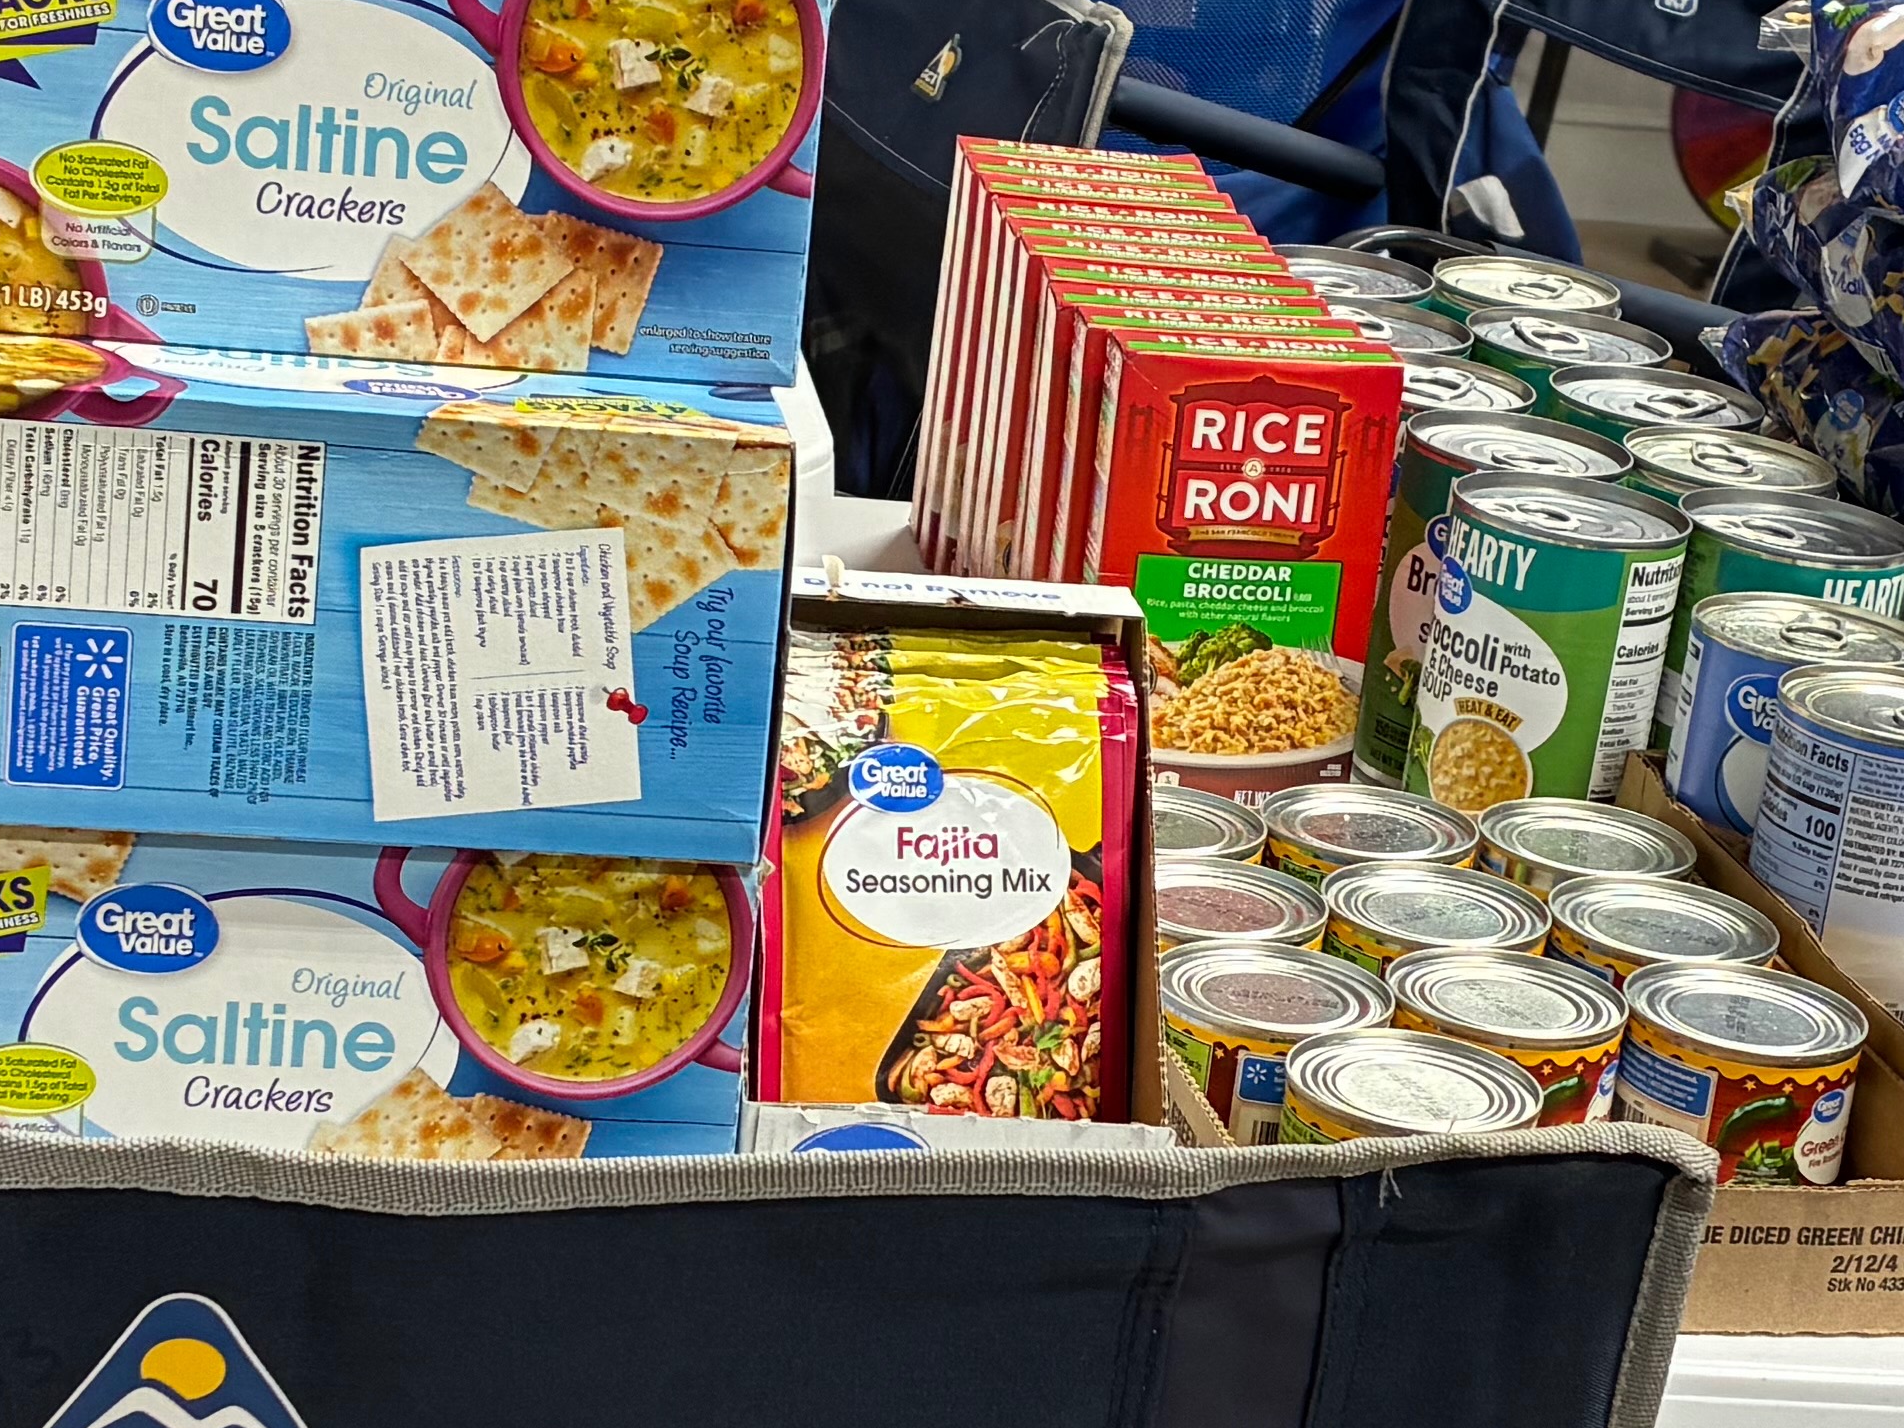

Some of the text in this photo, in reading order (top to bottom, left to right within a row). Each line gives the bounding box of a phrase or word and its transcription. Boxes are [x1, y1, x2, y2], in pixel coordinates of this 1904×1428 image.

[31, 2, 111, 27] FRESHNESS
[190, 27, 265, 55] Value
[364, 72, 477, 117] Original
[186, 95, 468, 185] Saltine
[256, 181, 406, 226] Crackers
[17, 285, 52, 312] LB)
[55, 289, 109, 317] 453g
[1191, 408, 1326, 455] RICE
[1184, 478, 1316, 524] RONI
[192, 439, 220, 611] Calories 70
[287, 444, 322, 619] Nutrition Facts
[1187, 562, 1292, 582] CHEDDAR
[1449, 516, 1537, 591] HEARTY
[1183, 583, 1292, 602] BROCCOLI
[702, 587, 734, 724] Try our favorite
[1503, 642, 1531, 660] with
[1422, 667, 1452, 702] SOUP
[1438, 658, 1499, 698] Cheese
[1500, 657, 1560, 687] Potato
[667, 629, 698, 760] Soup Recipe...
[1457, 700, 1517, 729] HEAT & EAT
[72, 685, 89, 770] Guaranteed.
[87, 686, 104, 765] Great Price.
[99, 687, 120, 781] Great Quality.
[862, 757, 928, 786] Great
[881, 780, 928, 800] Value
[897, 825, 1000, 868] Fajita
[846, 869, 1052, 900] Seasoning Mix
[96, 902, 195, 942] Great
[118, 931, 194, 957] Value
[292, 967, 404, 1008] Original
[114, 996, 395, 1072] Saltine
[183, 1075, 333, 1114] Crackers
[1729, 1225, 1790, 1245] DICED
[1796, 1226, 1864, 1246] GREEN
[1830, 1255, 1898, 1274] 2/12/4
